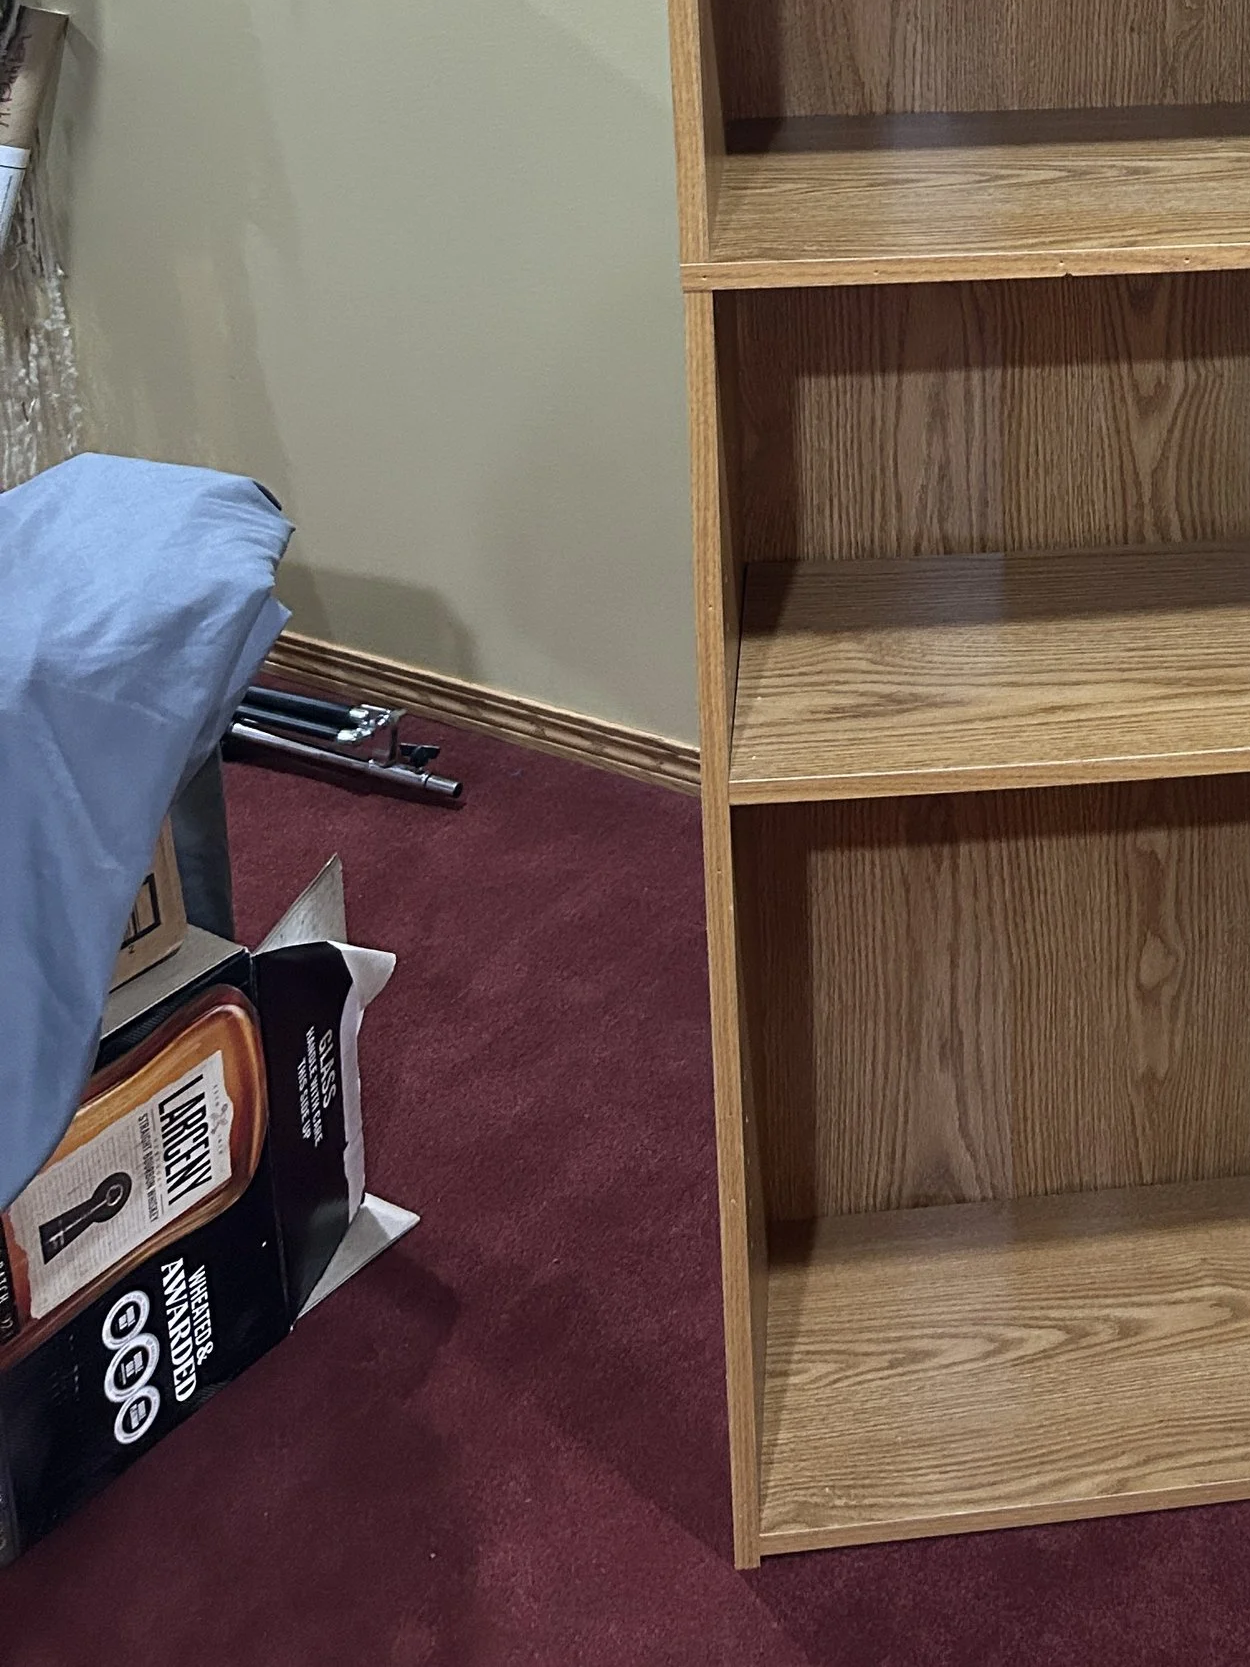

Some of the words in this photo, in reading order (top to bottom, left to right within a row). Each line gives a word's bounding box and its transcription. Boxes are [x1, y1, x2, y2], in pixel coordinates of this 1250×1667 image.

[306, 1025, 318, 1079] HANDLE
[318, 1028, 337, 1109] GLASS
[297, 1057, 308, 1092] THIS
[310, 1074, 321, 1113] WITH
[299, 1087, 311, 1126] SIDE
[138, 1112, 153, 1152] STRAIGHT
[158, 1073, 212, 1206] LARCENY
[301, 1119, 312, 1140] UP
[313, 1109, 324, 1148] CARE
[188, 1264, 212, 1346] WHEATED
[160, 1257, 197, 1402] AWARDED
[196, 1342, 214, 1366] &
